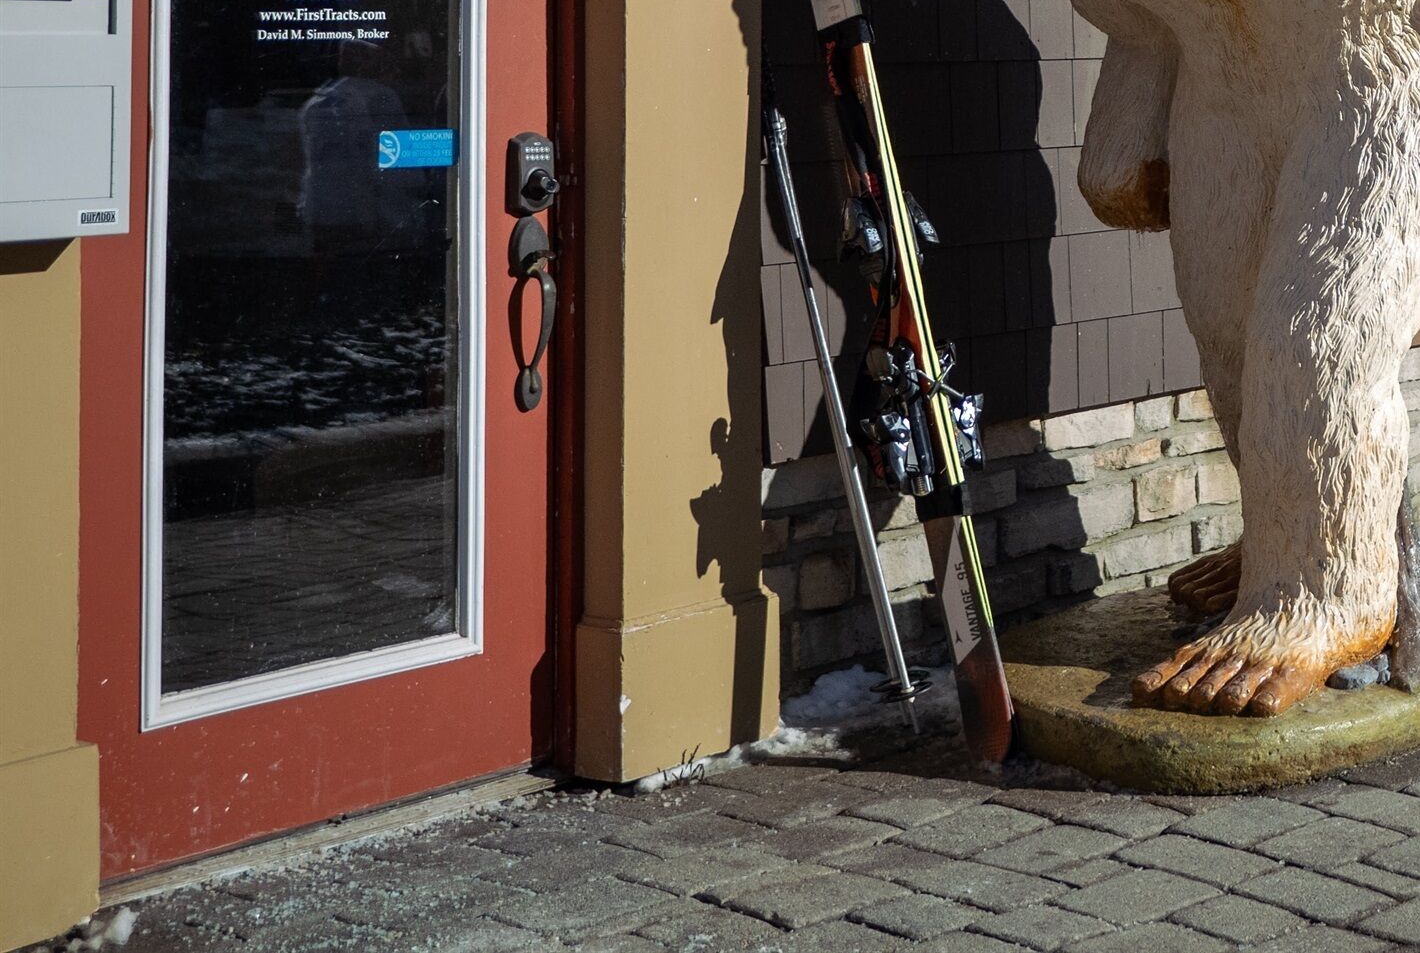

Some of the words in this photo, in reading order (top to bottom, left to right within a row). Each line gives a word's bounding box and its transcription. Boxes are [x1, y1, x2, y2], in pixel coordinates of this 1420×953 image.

[259, 8, 387, 21] www.FirstTracts.com
[257, 29, 289, 40] David
[291, 30, 305, 40] M.
[306, 29, 355, 41] Simmons,
[357, 28, 390, 40] Broker
[409, 132, 420, 141] NO
[961, 588, 981, 641] VANTAGE
